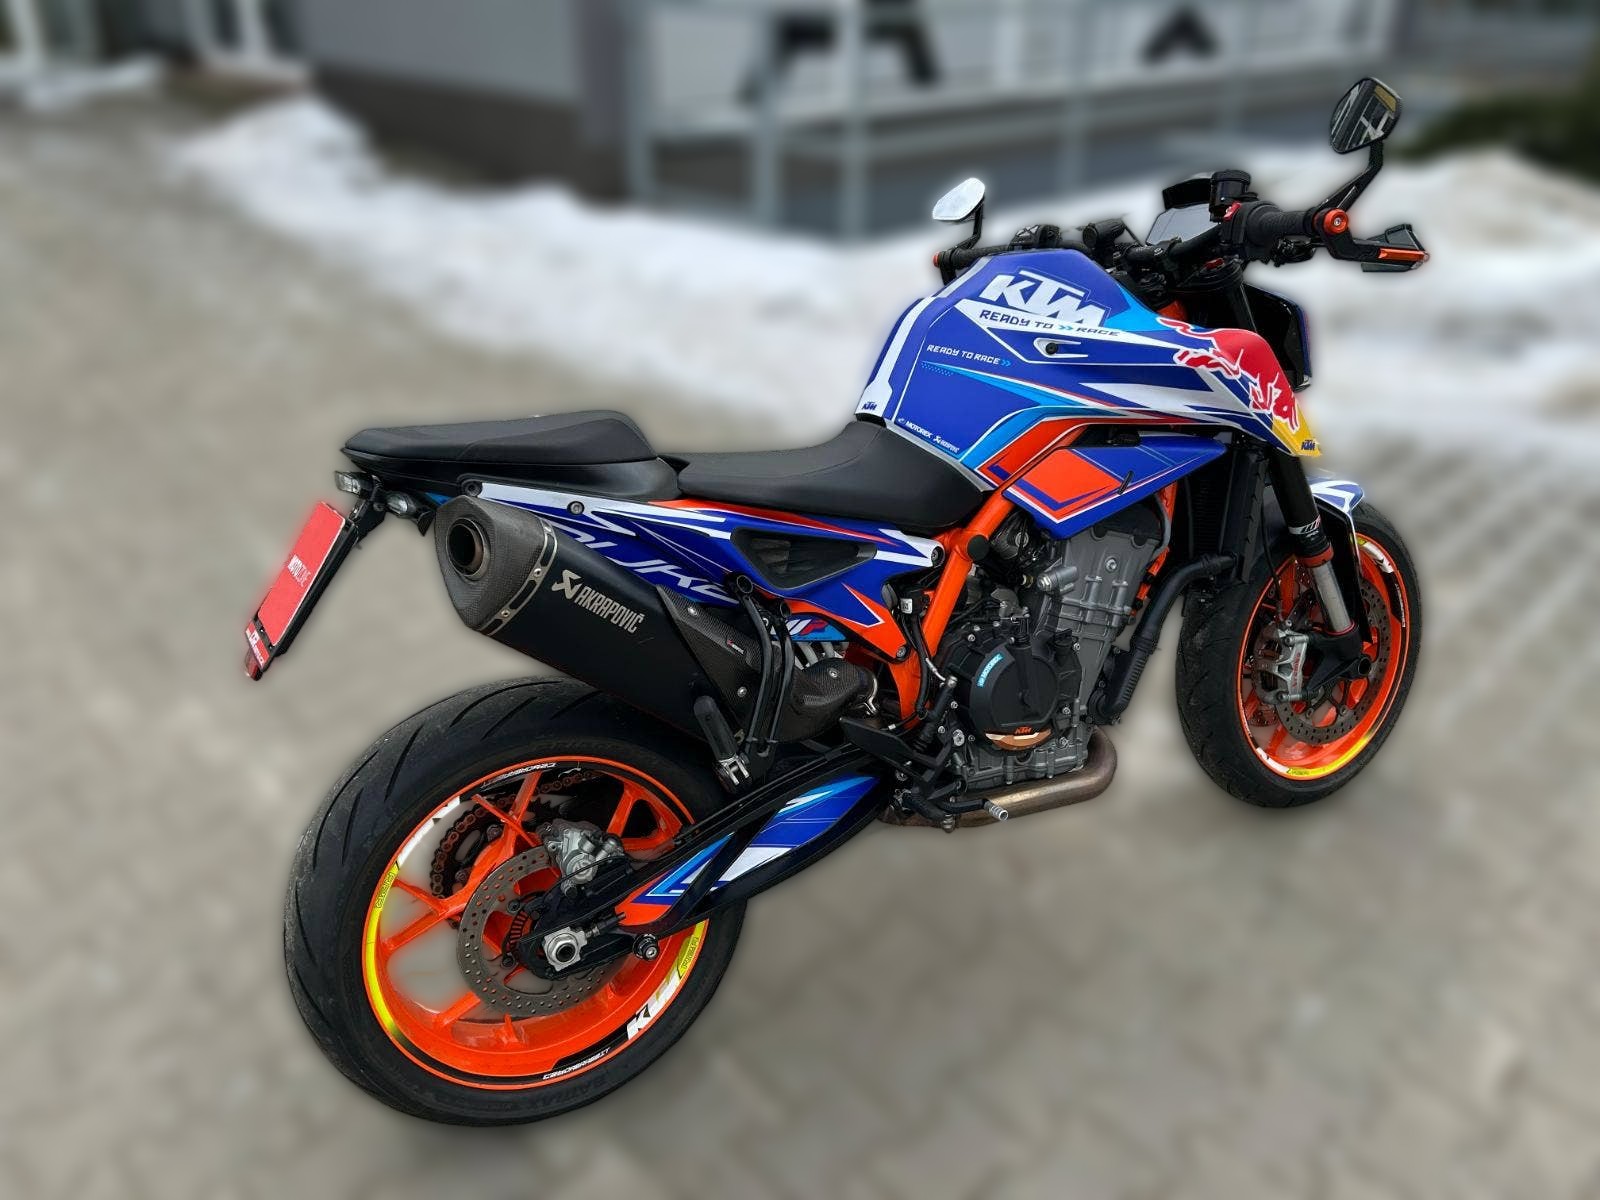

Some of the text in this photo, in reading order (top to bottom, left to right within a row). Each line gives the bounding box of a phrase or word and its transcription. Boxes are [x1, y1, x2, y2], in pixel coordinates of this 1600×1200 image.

[979, 270, 1106, 327] KTM
[979, 309, 1120, 336] READY TO RACE
[926, 344, 1000, 365] READY TO RACE
[861, 401, 877, 410] KTM
[1301, 439, 1315, 450] KTM
